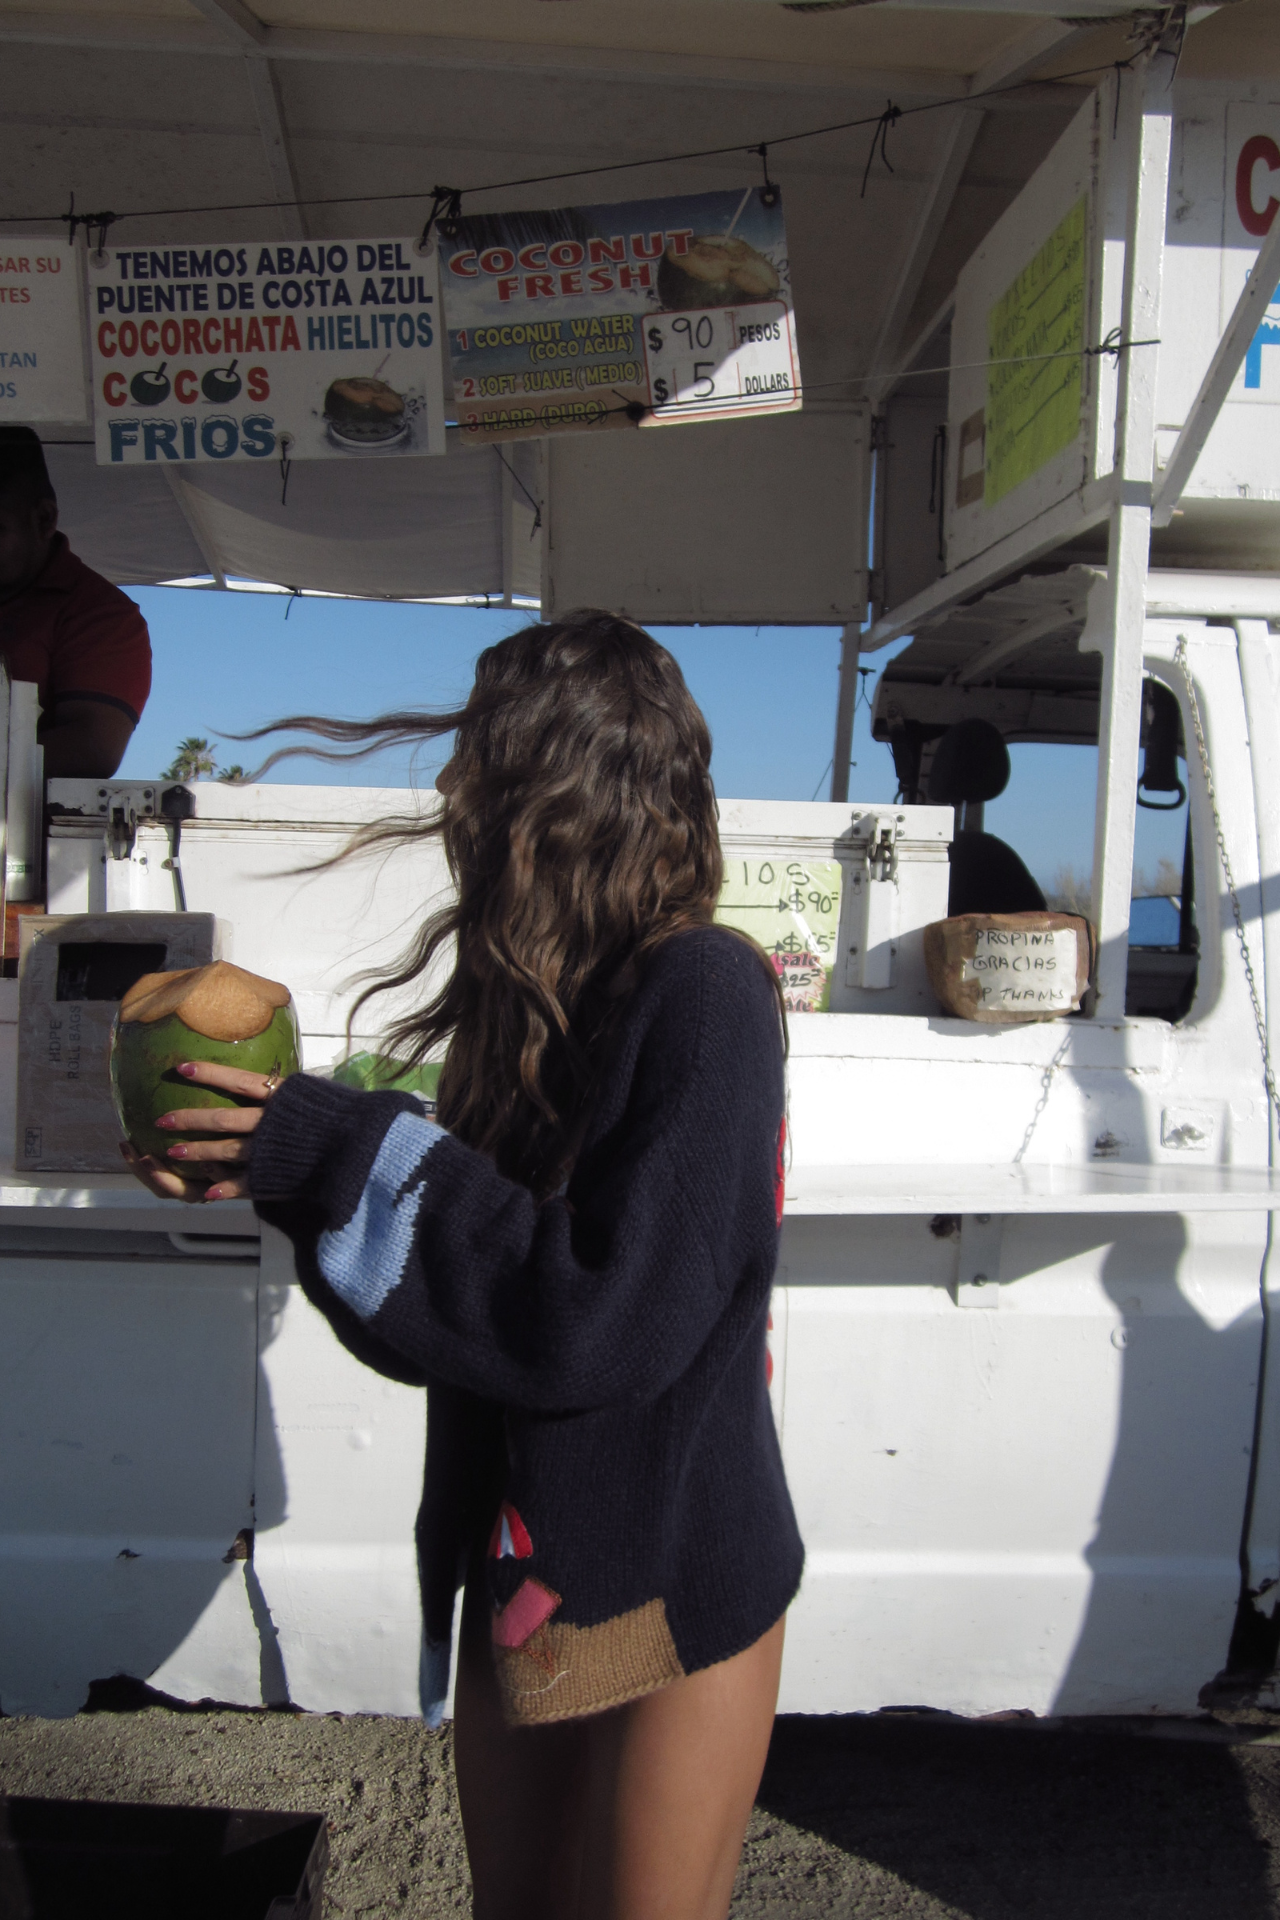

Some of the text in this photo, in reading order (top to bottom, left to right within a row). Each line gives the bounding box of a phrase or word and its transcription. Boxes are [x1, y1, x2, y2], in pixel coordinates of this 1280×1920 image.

[36, 257, 61, 274] SU
[116, 243, 411, 279] TENEMOS ABAJO DEL
[448, 228, 694, 278] COCONUT
[97, 276, 434, 314] PUENTE DE COSTA AZUL
[497, 261, 652, 303] FRESH
[97, 312, 433, 357] COCORCHATA HIELITOS
[456, 314, 634, 350] 1 COCONUT WATER
[529, 335, 634, 364] (COCO AGUA)
[648, 316, 781, 354] $ 90 PESOS
[463, 378, 476, 397] 2
[479, 374, 517, 397] SOFT
[523, 368, 573, 392] SUAVE
[653, 361, 790, 405] $ 5 DOLLARS
[466, 400, 607, 432] 3 HARD (DURO)
[108, 413, 277, 462] FRIOS
[974, 928, 1055, 946] PROPINA
[972, 955, 1057, 972] GRACIAS
[784, 997, 813, 1012] ale
[49, 1020, 62, 1062] HDPE
[69, 1005, 82, 1041] BAGS
[67, 1045, 81, 1079] ROLL
